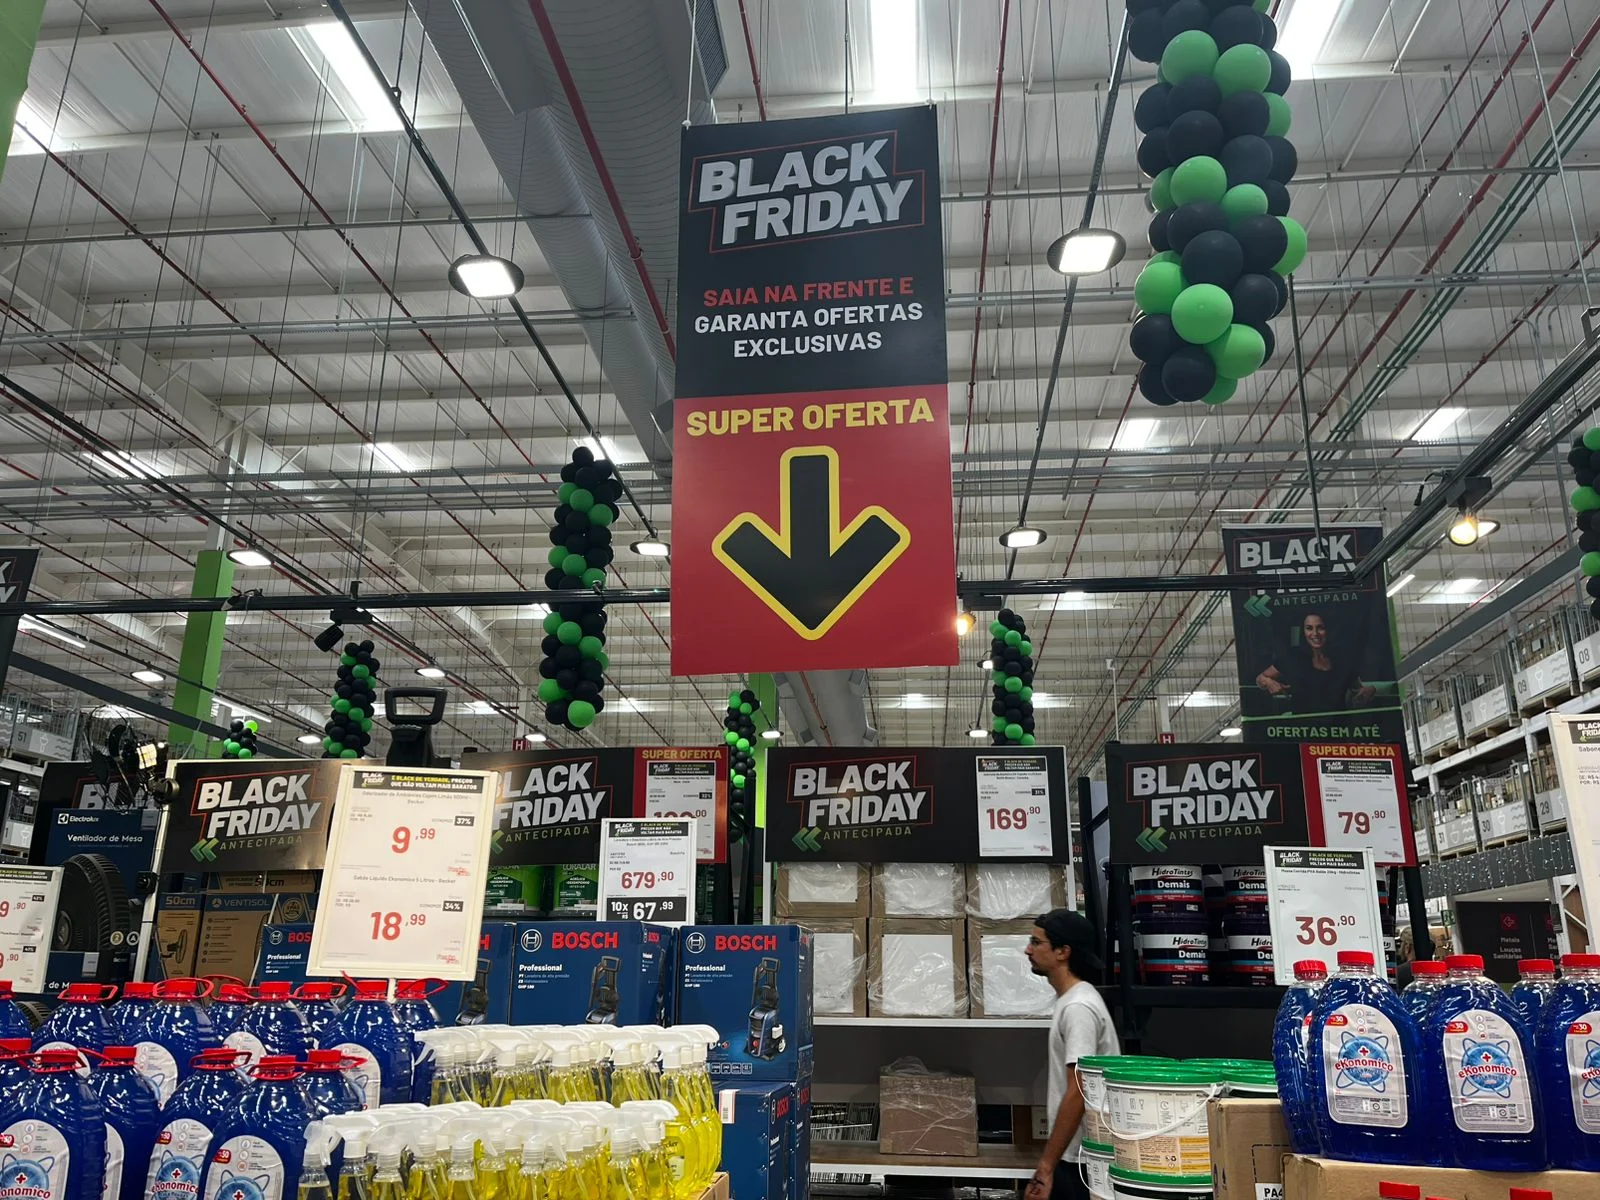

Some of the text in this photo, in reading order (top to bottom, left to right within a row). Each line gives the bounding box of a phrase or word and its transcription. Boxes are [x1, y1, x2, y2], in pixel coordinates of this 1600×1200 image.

[699, 138, 888, 202] BLACK
[722, 179, 914, 245] FRIDAY
[704, 277, 913, 306] SAIA NA FRENTE E
[695, 302, 923, 333] GARANTA OFERTAS
[734, 331, 882, 357] EXCLUSIVAS
[687, 398, 934, 436] SUPER OFERTA
[1240, 534, 1352, 568] BLACK
[1274, 592, 1358, 606] ANTECIPADA
[1579, 648, 1590, 663] 08
[1518, 680, 1527, 694] 09
[1267, 724, 1380, 738] OFERTAS EM ATÉ
[642, 750, 722, 759] SUPER OFERTA
[1309, 746, 1395, 757] SUPER OFERTA
[793, 761, 911, 797] BLACK
[1133, 759, 1257, 796] BLACK
[198, 774, 311, 810] BLACK
[492, 791, 606, 830] FRIDAY
[808, 792, 927, 828] FRIDAY
[1151, 790, 1275, 828] FRIDAY
[1540, 801, 1550, 815] 29
[207, 803, 321, 838] FRIDAY
[1482, 820, 1491, 833] 30
[68, 834, 107, 842] Ventilador
[506, 826, 590, 843] ANTECIPADA
[823, 826, 912, 840] ANTECIPADA
[1169, 826, 1262, 841] ANTECIPADA
[220, 836, 303, 850] ANTECIPADA
[1152, 868, 1194, 877] HidroTintas
[1234, 868, 1265, 877] HidroTin
[1158, 880, 1191, 889] Demais
[166, 896, 196, 905] 50cm
[224, 898, 270, 907] VENTISOL
[444, 902, 461, 910] 34%
[612, 902, 629, 912] 10x
[288, 932, 312, 943] BOS
[552, 932, 619, 949] BOSCH
[715, 935, 776, 951] BOSCH
[1179, 951, 1206, 959] Demais
[520, 964, 562, 972] Professional
[49, 981, 60, 989] de
[1335, 1058, 1394, 1072] eKonomico
[1458, 1064, 1517, 1079] eKonomico
